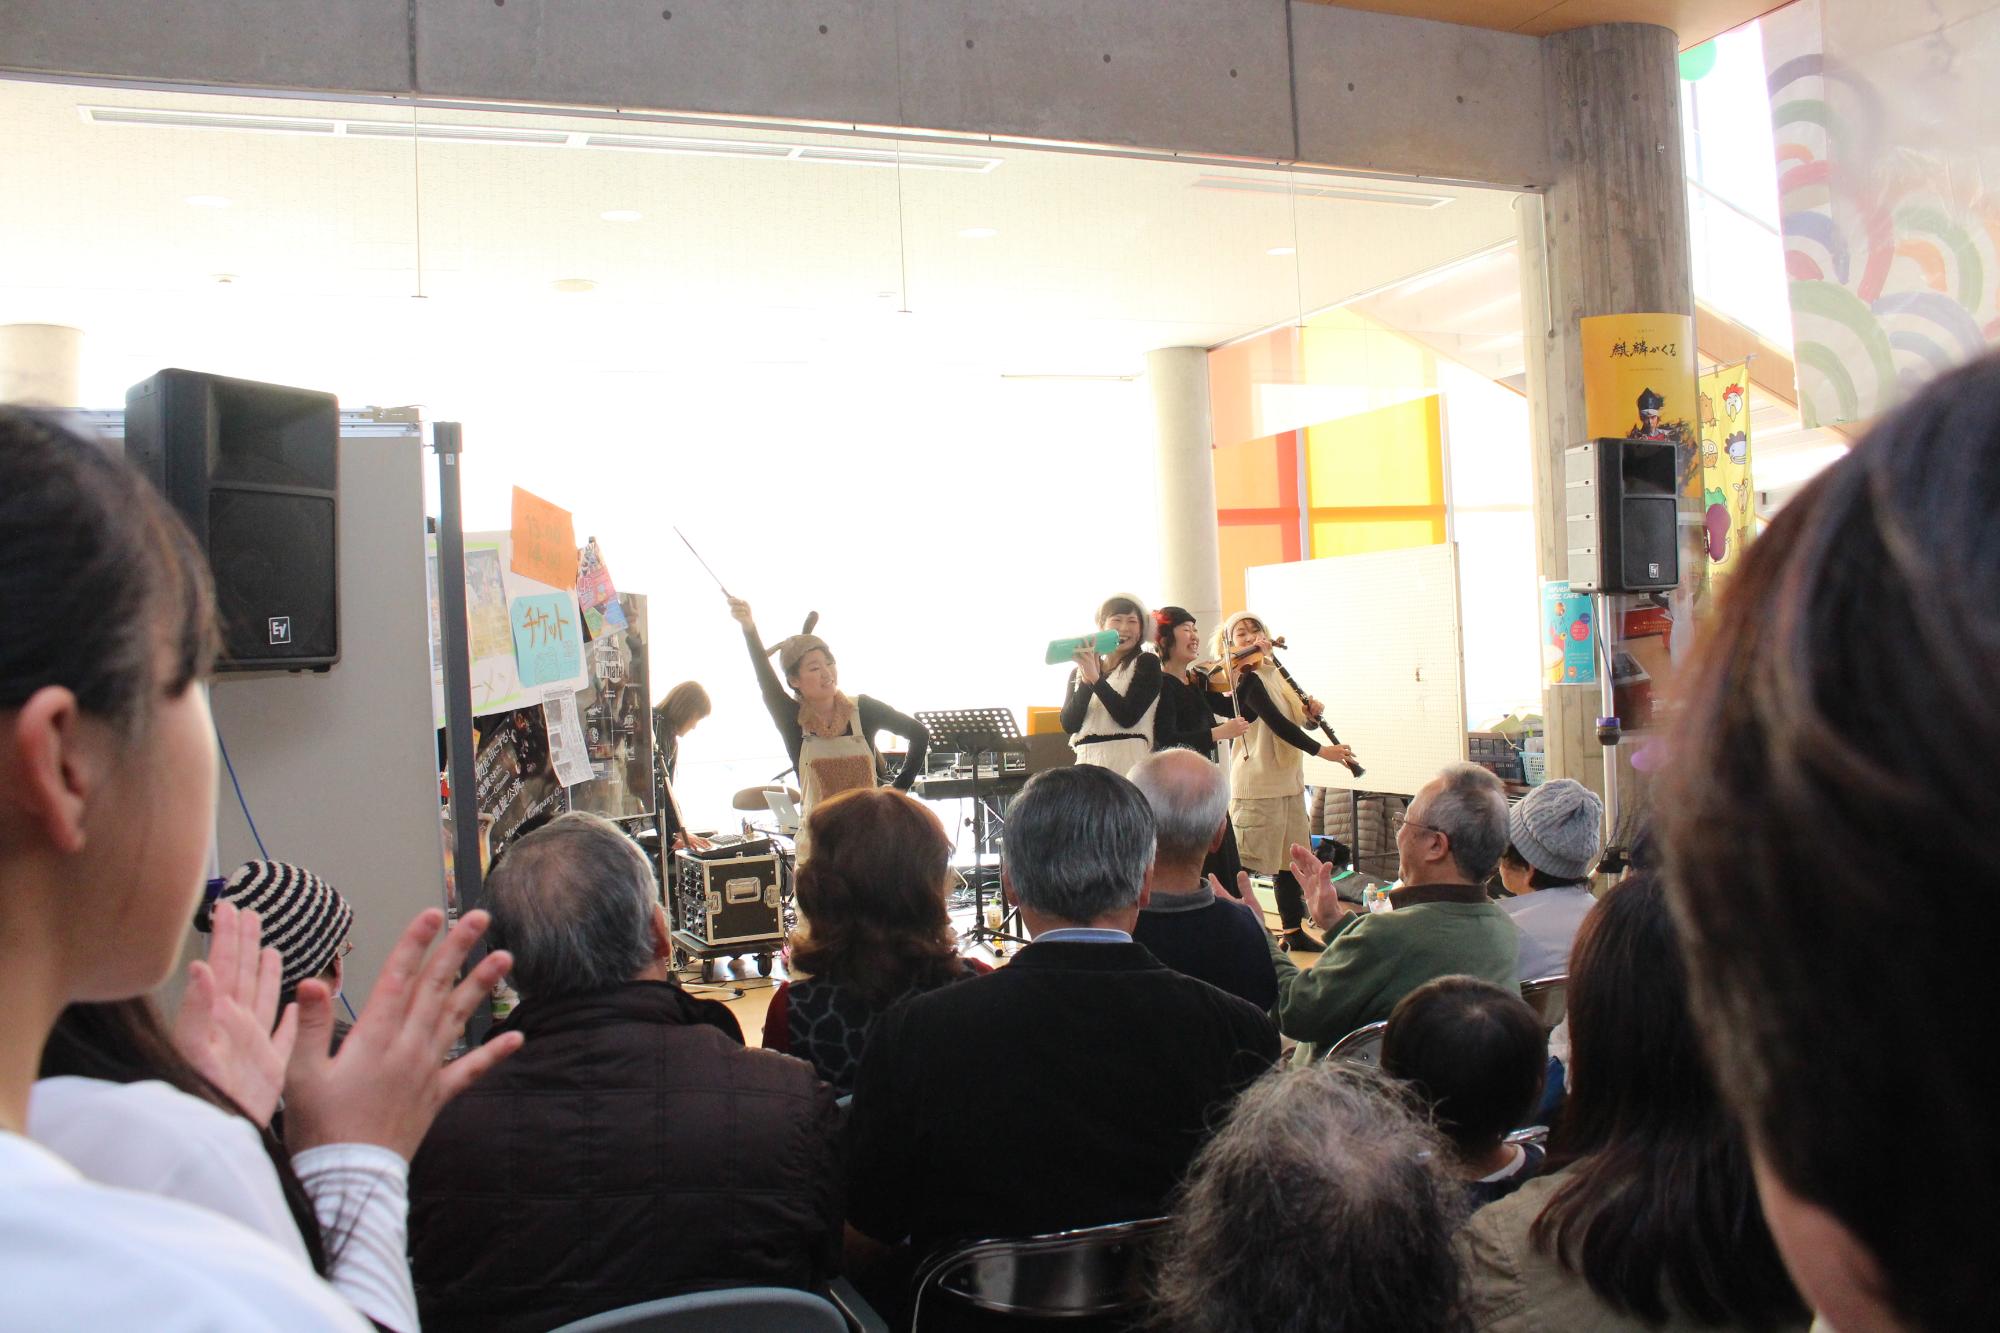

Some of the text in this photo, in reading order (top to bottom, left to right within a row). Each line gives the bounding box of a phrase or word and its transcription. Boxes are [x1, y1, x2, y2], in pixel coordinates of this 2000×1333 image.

[271, 620, 288, 640] EV
[523, 603, 569, 648] チケット
